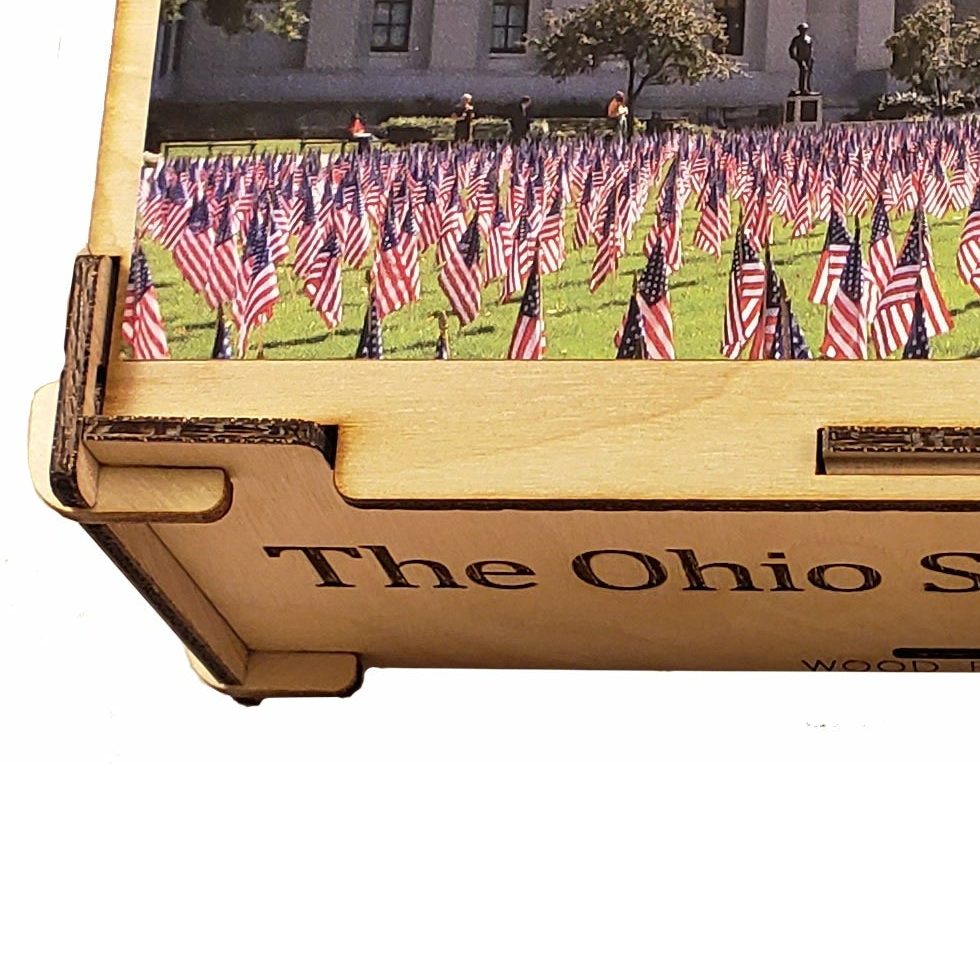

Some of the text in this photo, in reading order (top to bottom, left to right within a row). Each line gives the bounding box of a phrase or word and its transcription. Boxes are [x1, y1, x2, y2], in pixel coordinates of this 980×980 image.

[264, 546, 537, 590] The
[571, 549, 882, 593] Ohio
[801, 659, 940, 672] WOOD
